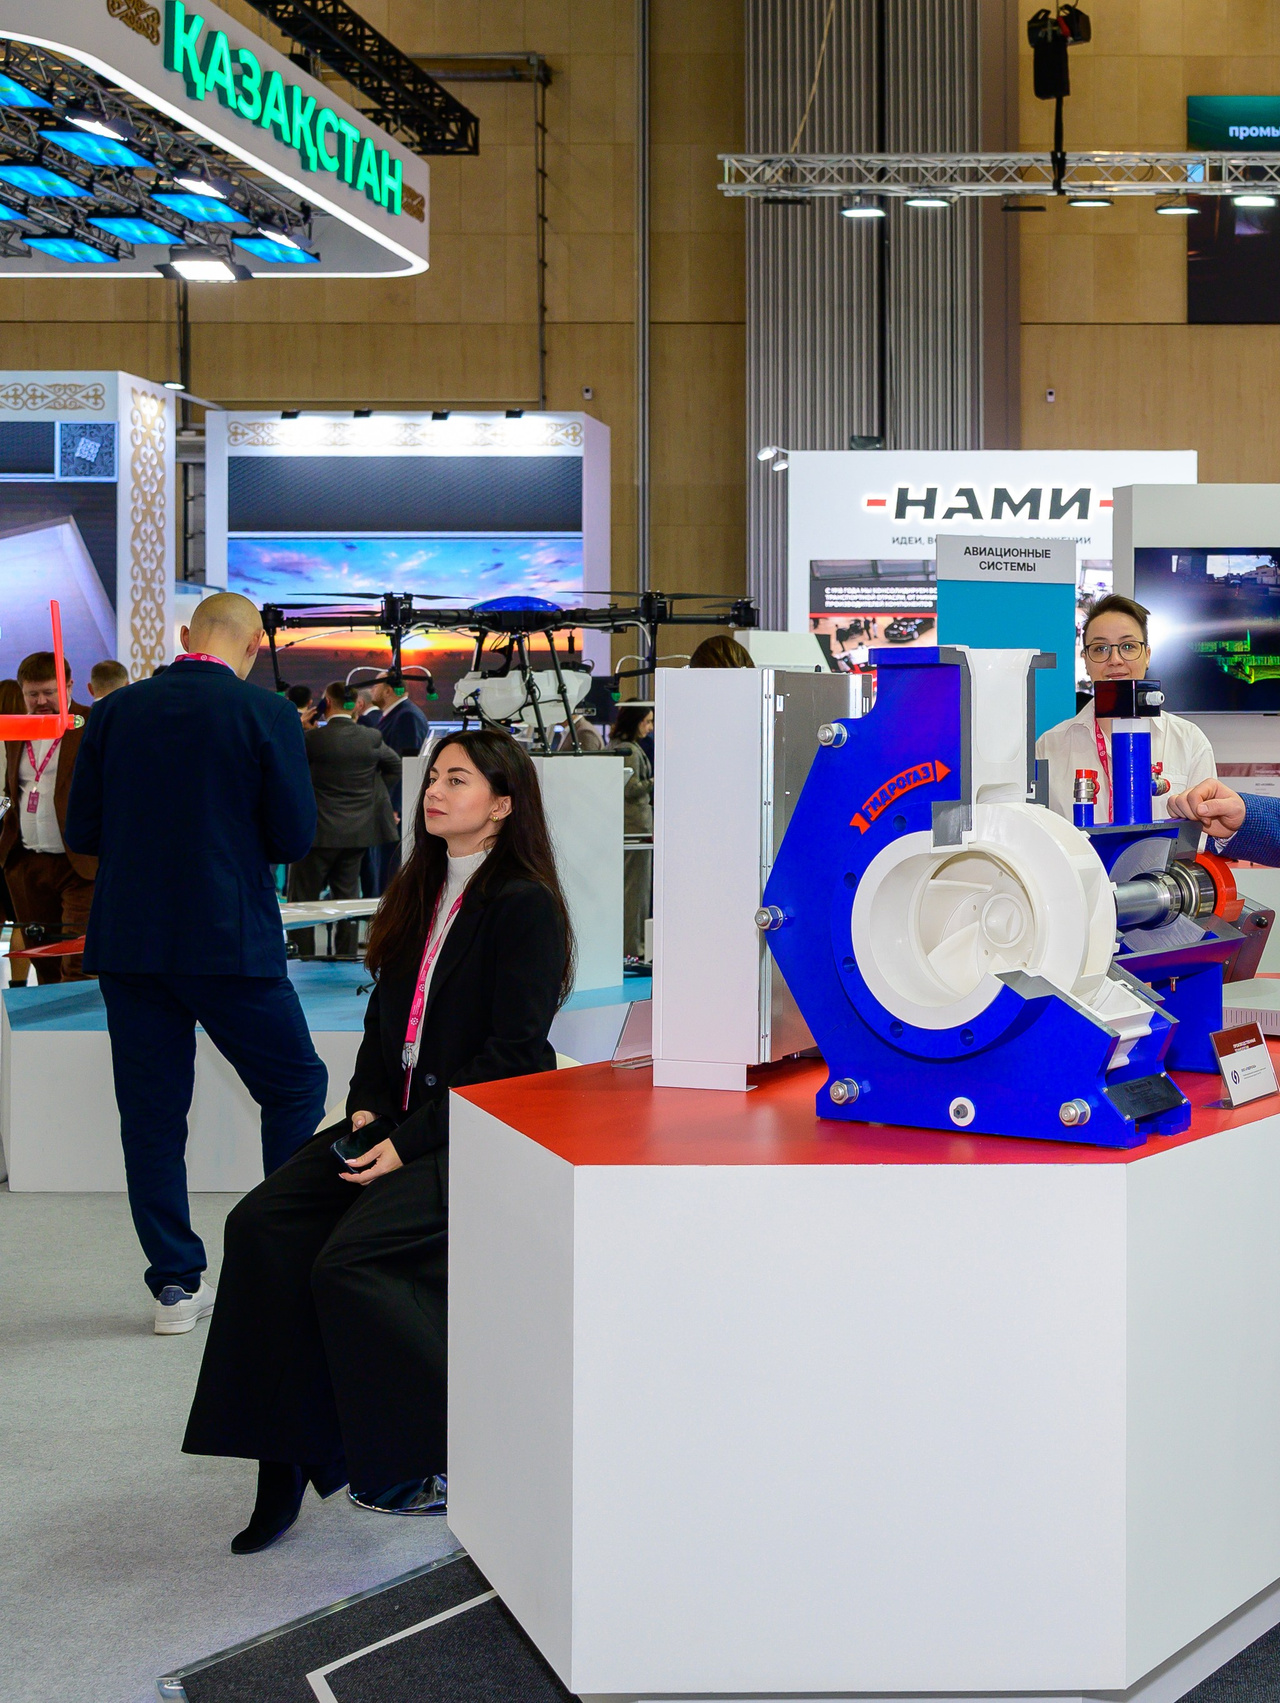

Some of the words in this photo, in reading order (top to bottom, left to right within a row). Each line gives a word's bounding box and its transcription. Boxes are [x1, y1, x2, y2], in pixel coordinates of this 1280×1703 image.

[166, 0, 403, 216] ҚАЗАҚСТАН
[895, 487, 1092, 520] НАМИ
[892, 536, 925, 545] ИДЕИ,
[963, 546, 1051, 559] АВИАЦИОННЫЕ
[979, 561, 1036, 572] СИСТЕМЫ
[864, 766, 931, 818] ГИДРОГАЗ
